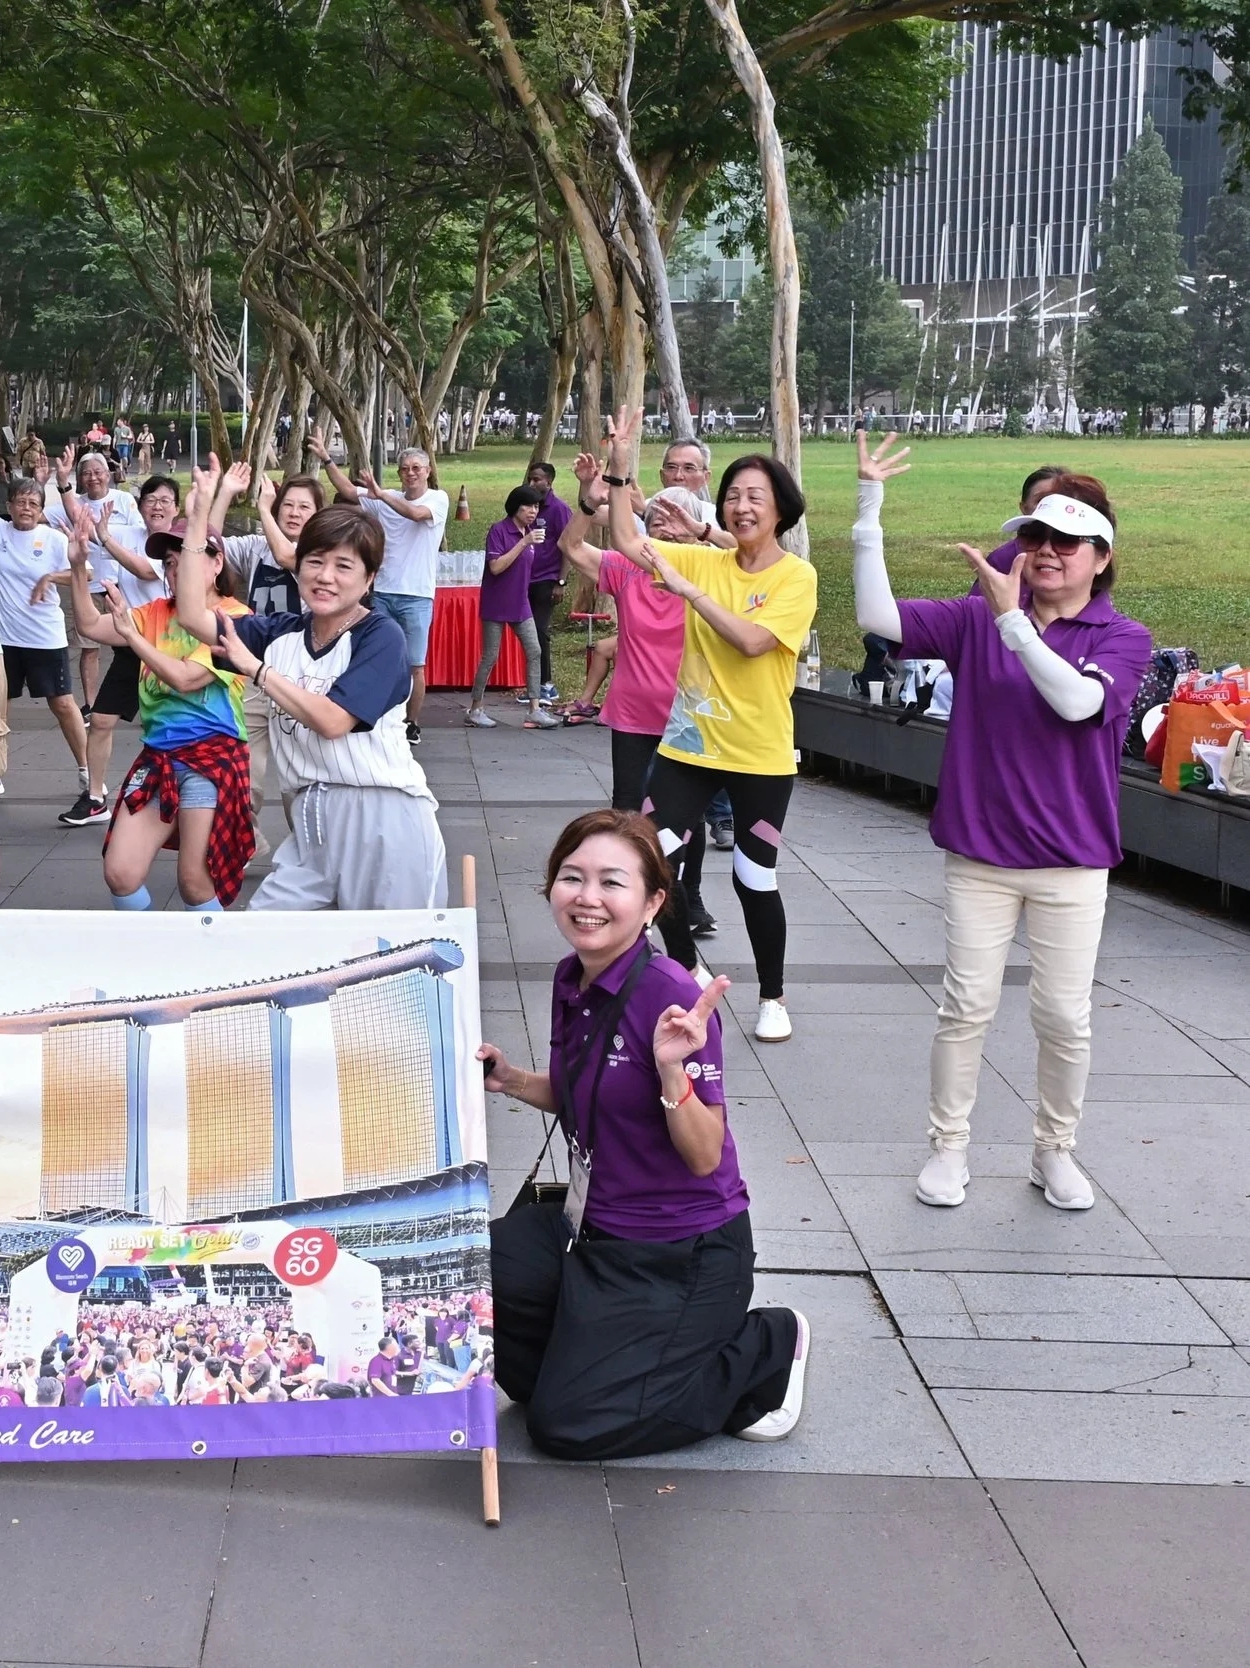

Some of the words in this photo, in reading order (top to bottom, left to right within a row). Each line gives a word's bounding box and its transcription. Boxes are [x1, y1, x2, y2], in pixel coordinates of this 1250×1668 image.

[108, 1234, 155, 1250] READY
[160, 1233, 188, 1248] SET
[288, 1236, 324, 1256] SG
[285, 1256, 320, 1277] 60
[29, 1420, 95, 1449] Care
